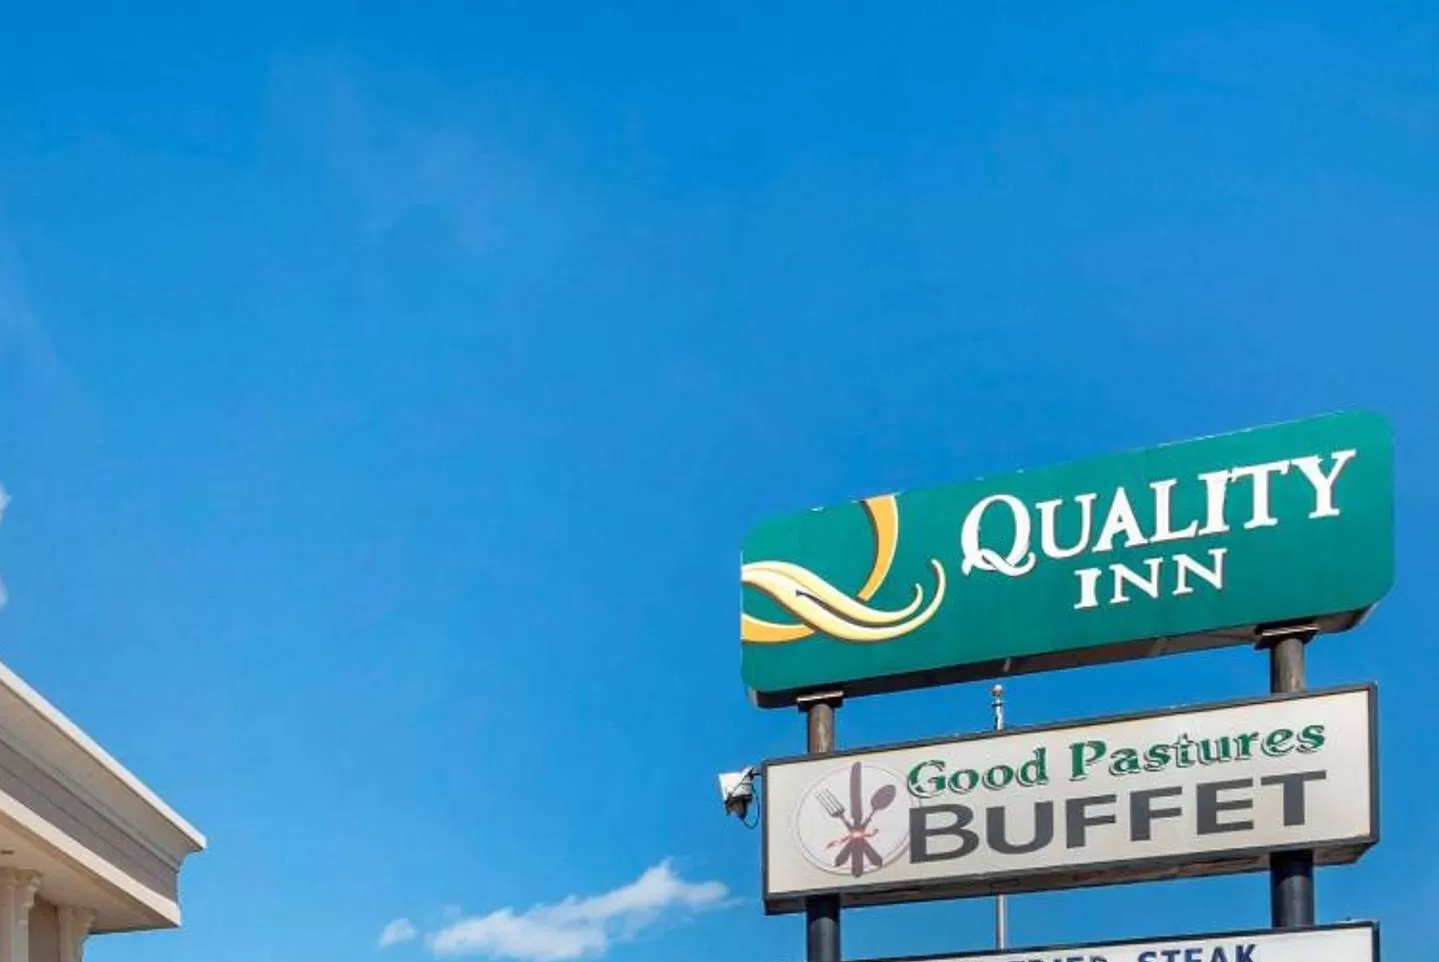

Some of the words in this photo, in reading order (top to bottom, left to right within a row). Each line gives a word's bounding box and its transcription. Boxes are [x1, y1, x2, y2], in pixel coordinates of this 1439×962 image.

[961, 449, 1357, 577] QUALITY
[1074, 547, 1228, 609] INN
[907, 747, 1050, 799] Good
[1069, 721, 1327, 781] Pastures
[908, 770, 1327, 864] BUFFET
